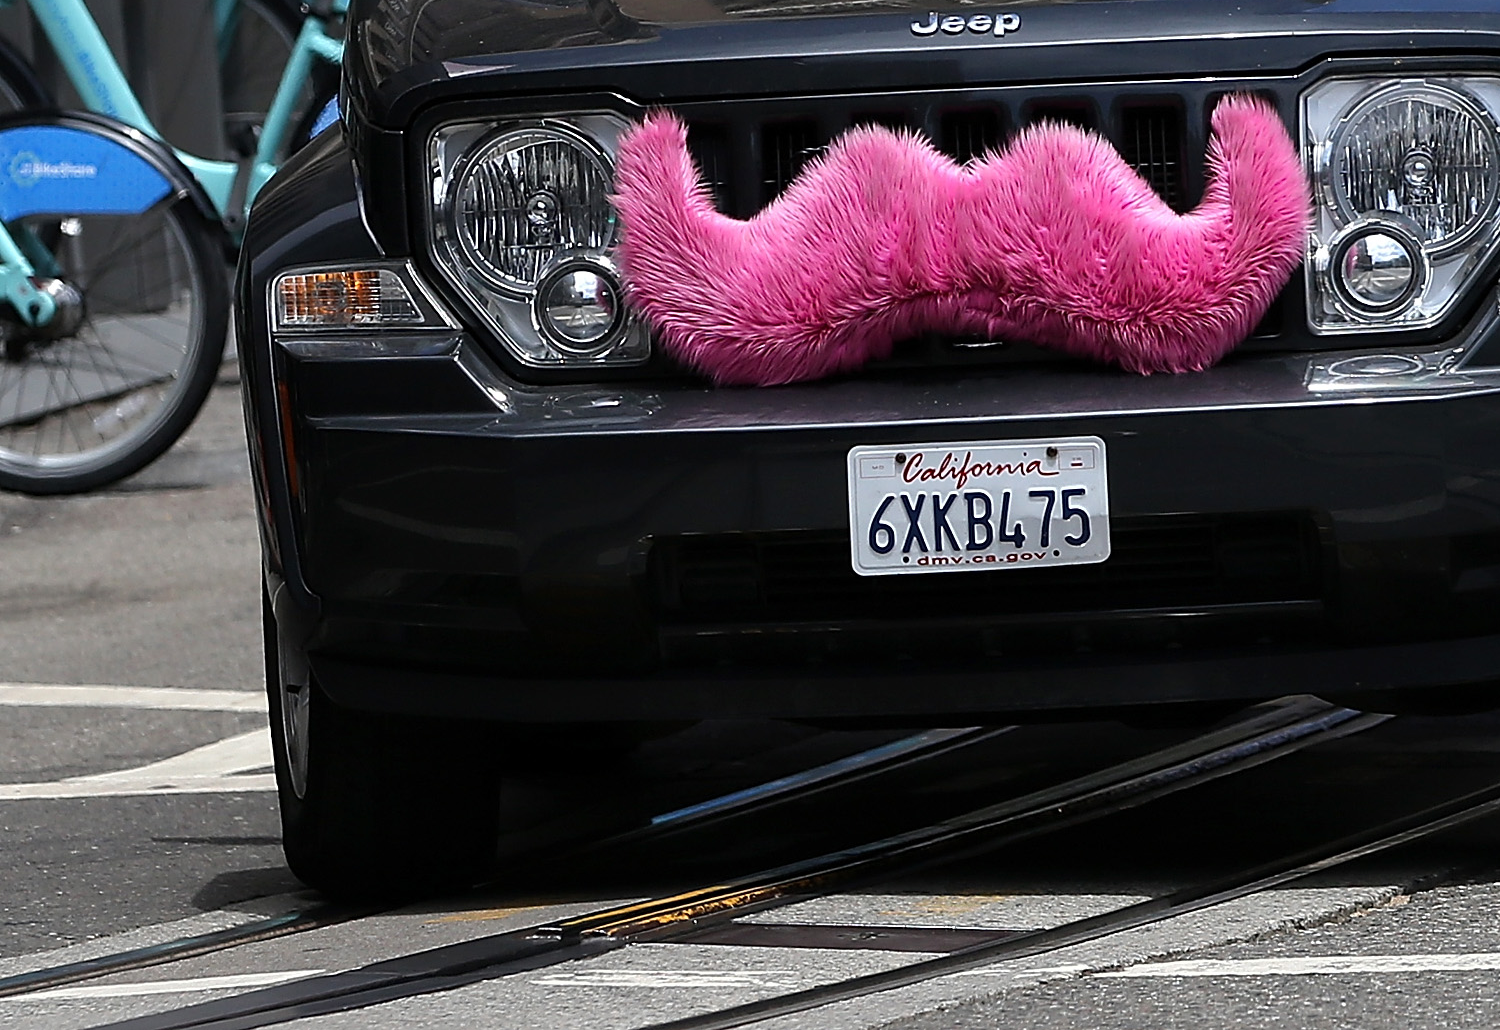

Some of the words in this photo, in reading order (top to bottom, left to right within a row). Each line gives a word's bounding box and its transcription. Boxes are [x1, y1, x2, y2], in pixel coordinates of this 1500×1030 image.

[911, 11, 1020, 38] Jeep
[903, 451, 1059, 489] California
[868, 488, 1091, 555] 6XKB475
[917, 550, 1047, 567] dmv.ca.gov
